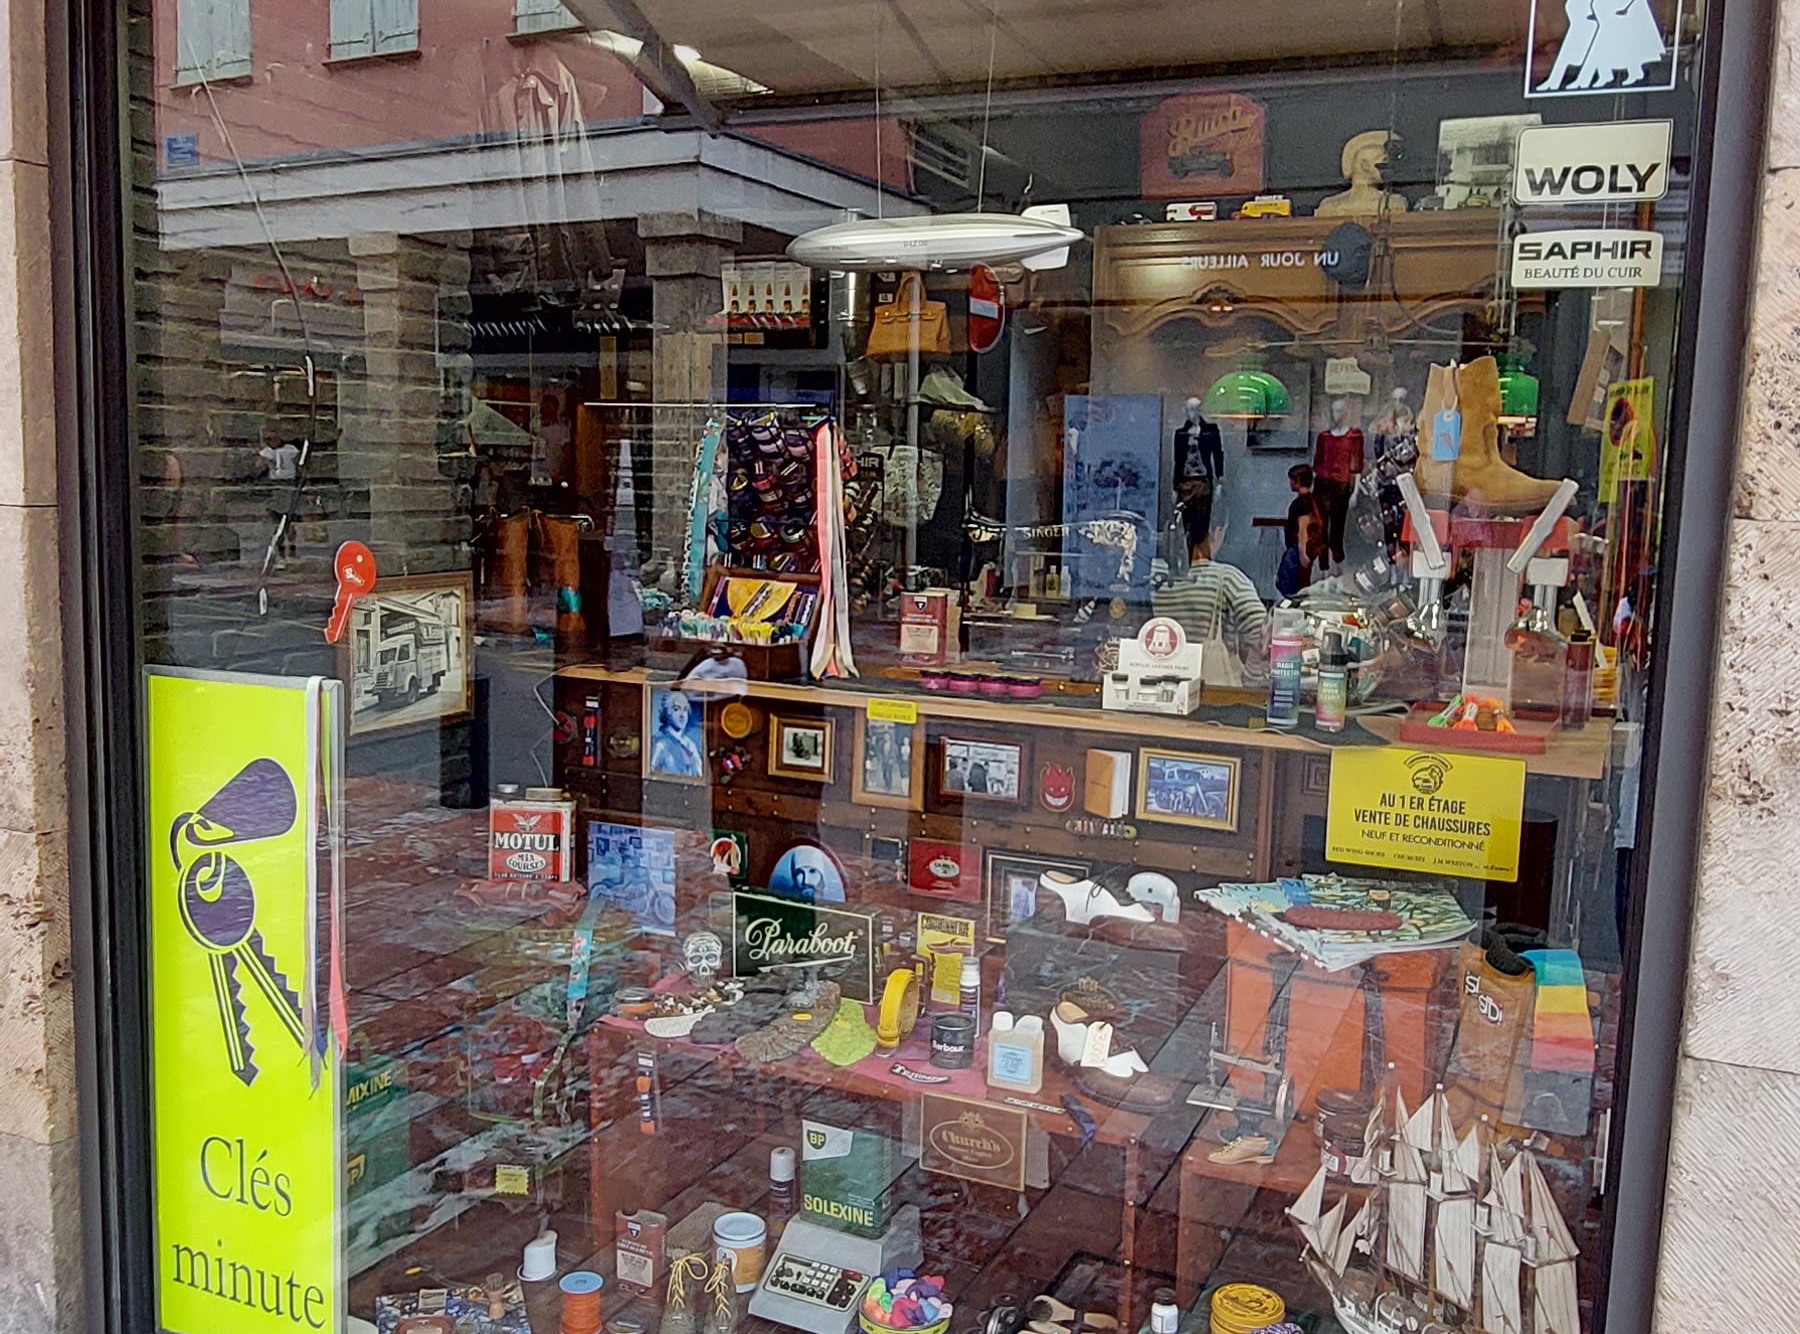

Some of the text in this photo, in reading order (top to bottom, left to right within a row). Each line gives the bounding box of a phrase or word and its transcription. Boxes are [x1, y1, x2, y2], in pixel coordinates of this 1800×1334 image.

[1524, 162, 1661, 196] WOLY
[1518, 240, 1652, 261] SAPHIR
[1524, 265, 1643, 279] BEAUTÉ DU CUIR
[1022, 525, 1070, 539] SINGER
[1379, 792, 1466, 816] AU 1 ER ÉTAGE
[1354, 809, 1491, 836] VENTE DE CHAUSSURES
[494, 832, 559, 851] MOTUL
[1361, 829, 1485, 851] NEUF ET RECONDITIONNÉ
[508, 858, 545, 870] COURSES
[745, 918, 857, 960] Paraboot
[808, 1133, 825, 1146] BP
[201, 1136, 292, 1217] Clés
[803, 1193, 874, 1227] SOLEXINE
[172, 1238, 326, 1329] minute
